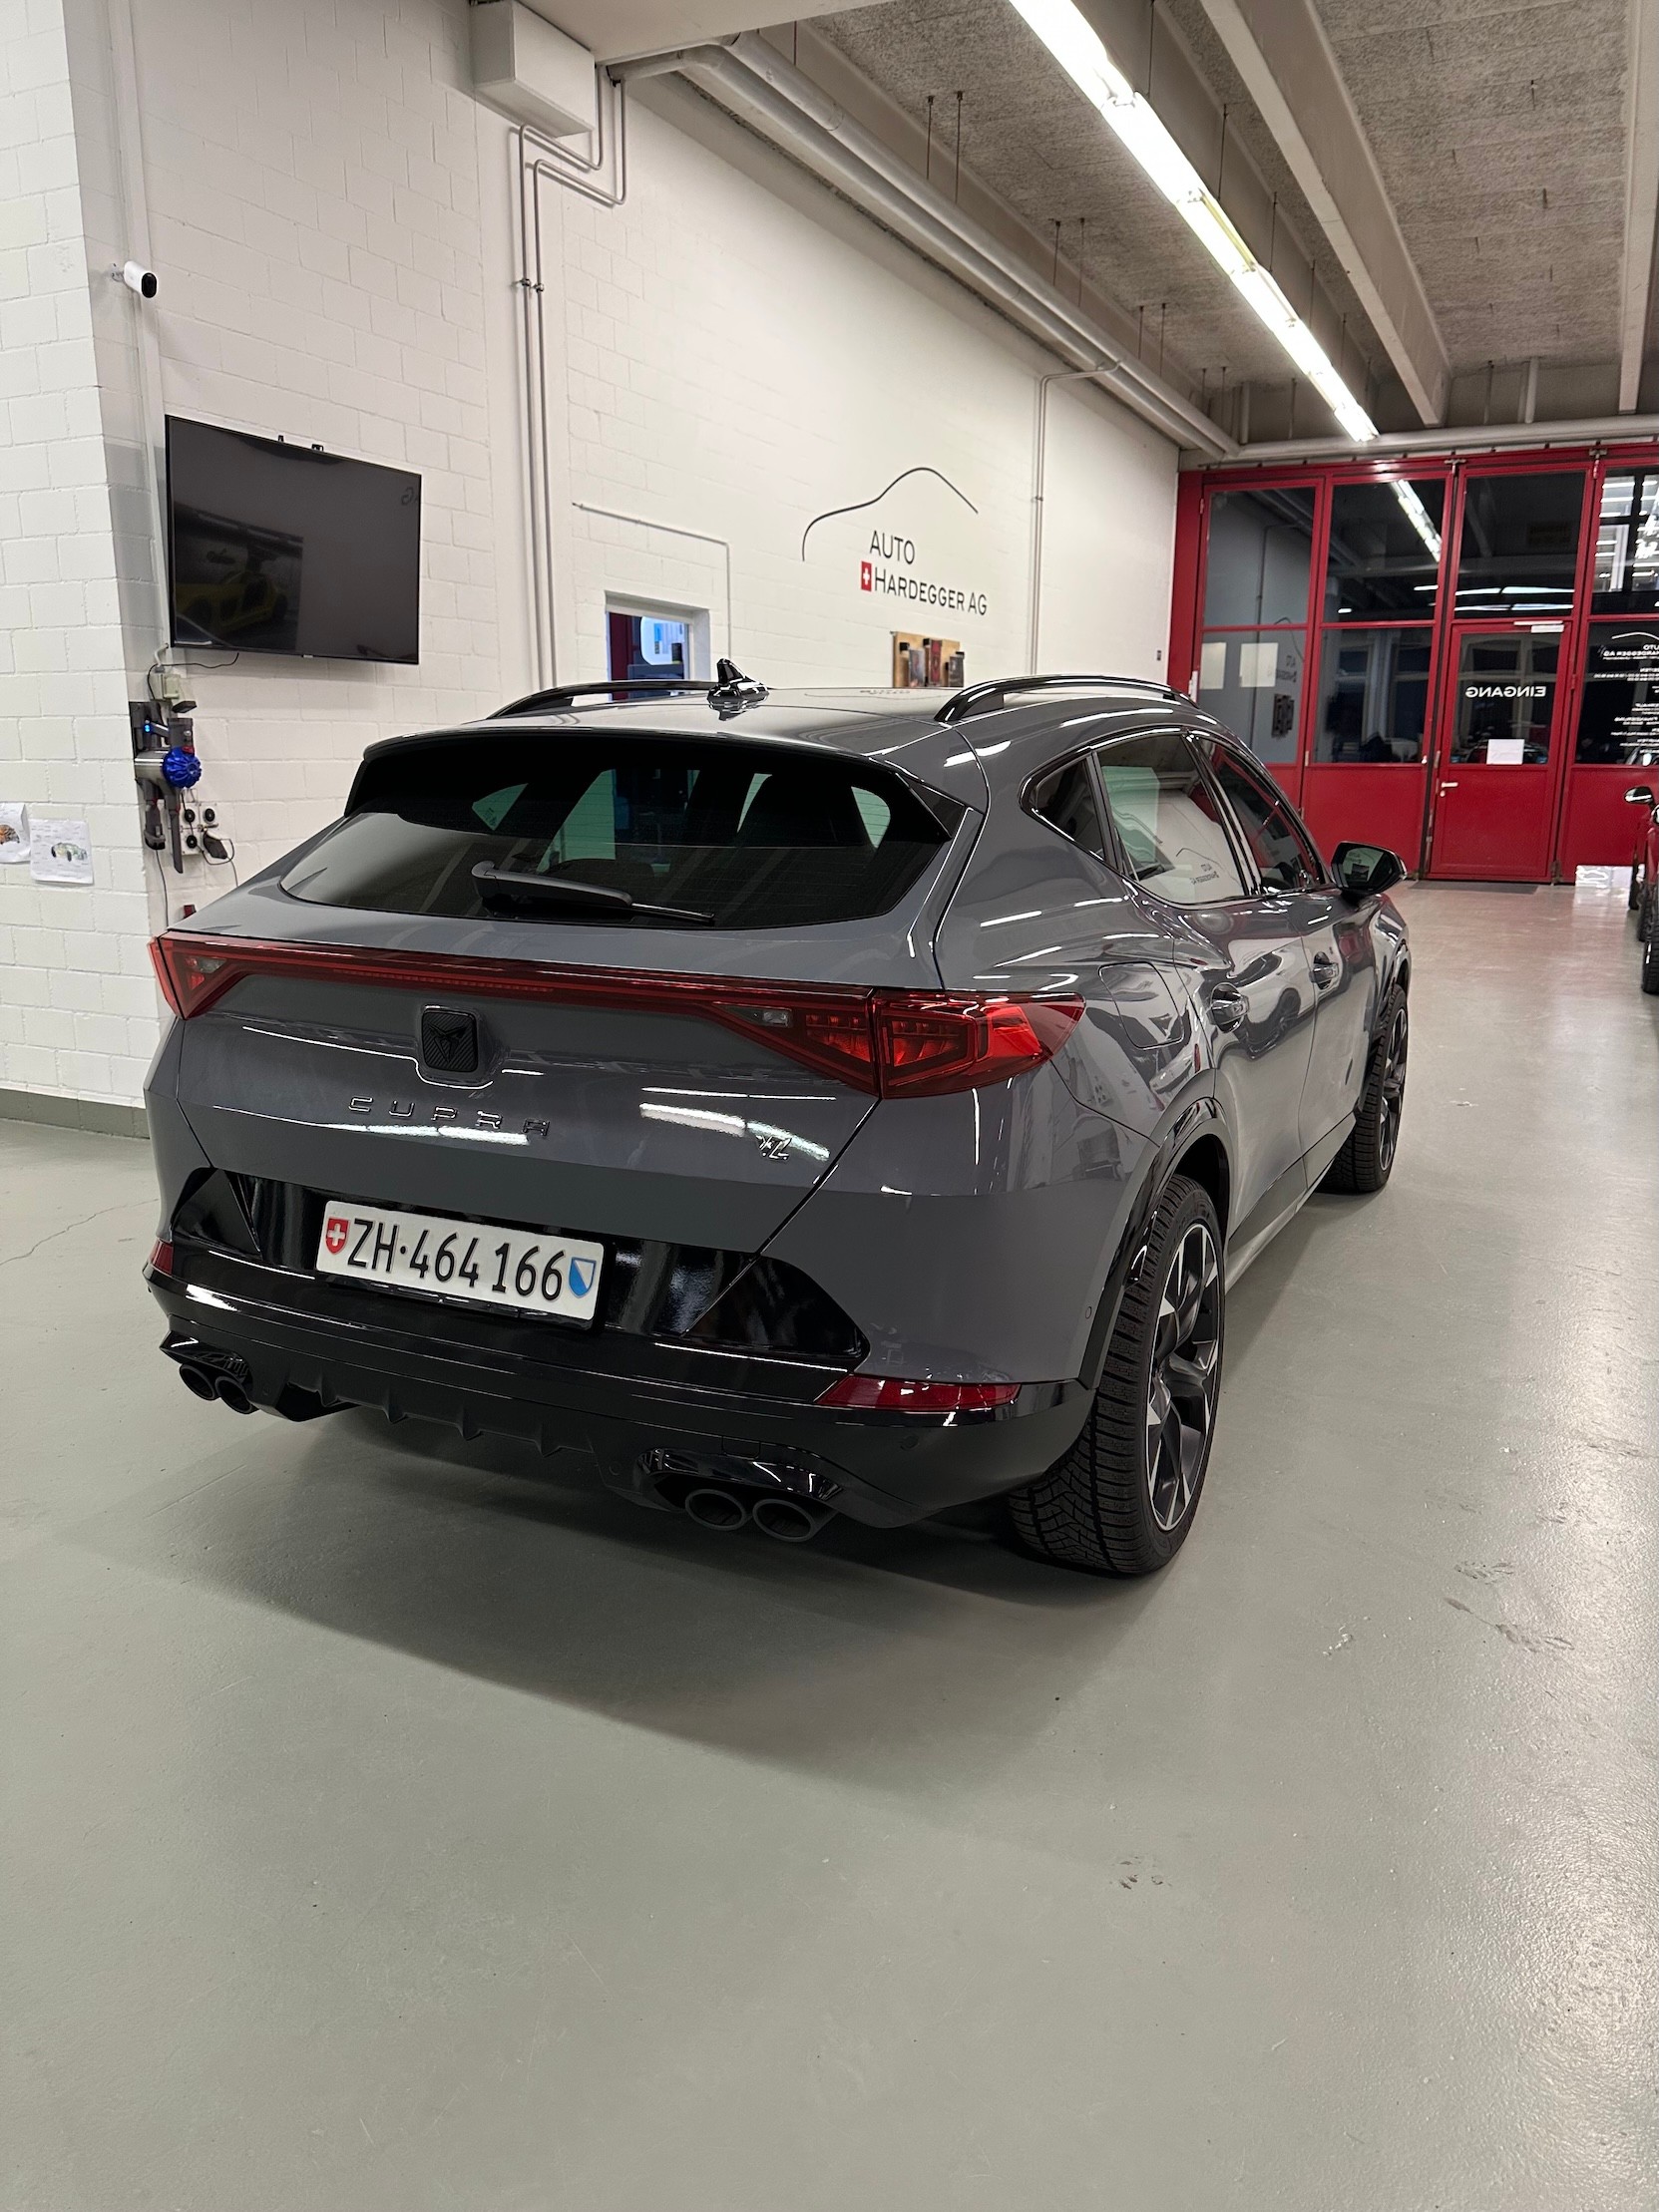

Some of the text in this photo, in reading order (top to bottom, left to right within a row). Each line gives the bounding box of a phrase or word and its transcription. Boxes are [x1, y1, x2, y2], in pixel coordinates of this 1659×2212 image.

[870, 530, 916, 564] AUTO
[874, 566, 988, 615] HARDEGGER AG
[348, 1096, 550, 1136] CUPRA
